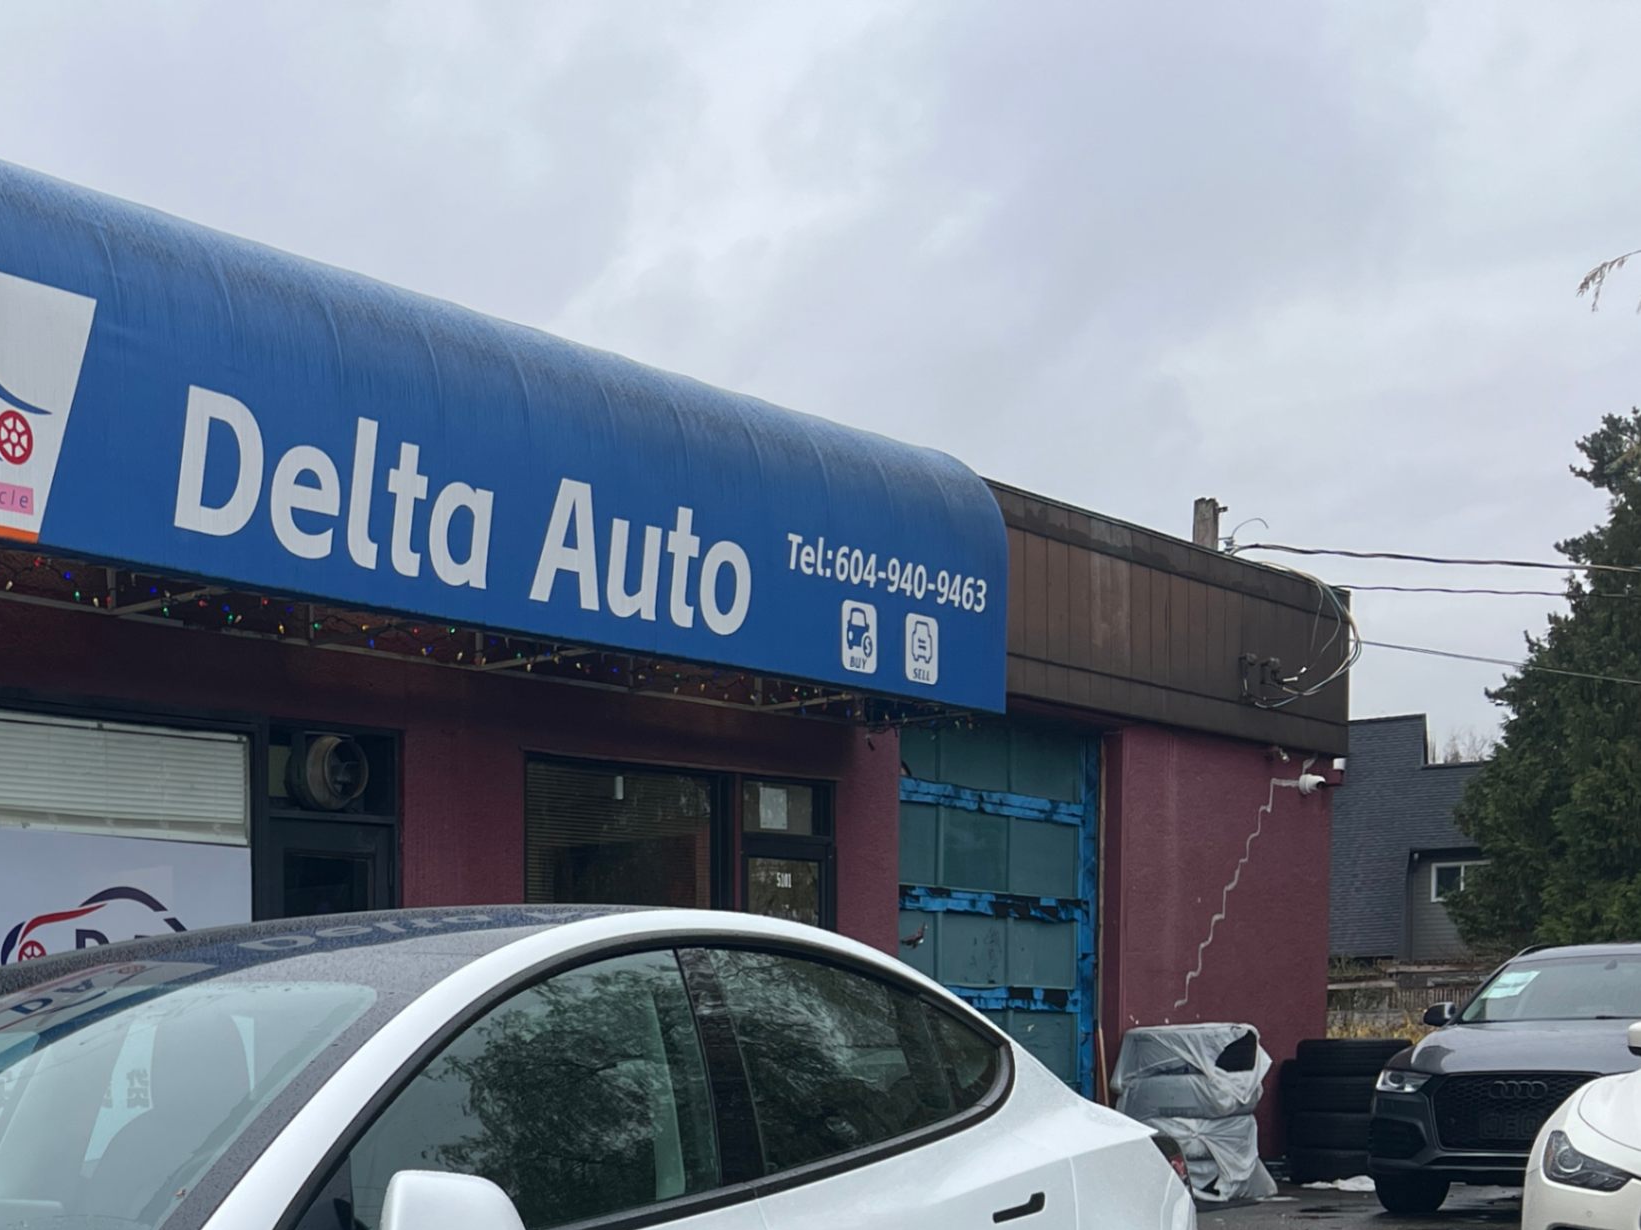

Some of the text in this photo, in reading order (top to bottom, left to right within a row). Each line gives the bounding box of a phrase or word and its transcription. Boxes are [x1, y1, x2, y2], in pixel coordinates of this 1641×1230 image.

[173, 385, 753, 636] Delta Auto
[787, 532, 988, 614] Tel:604-940-9463
[849, 655, 868, 671] BUY
[912, 667, 931, 682] SELL
